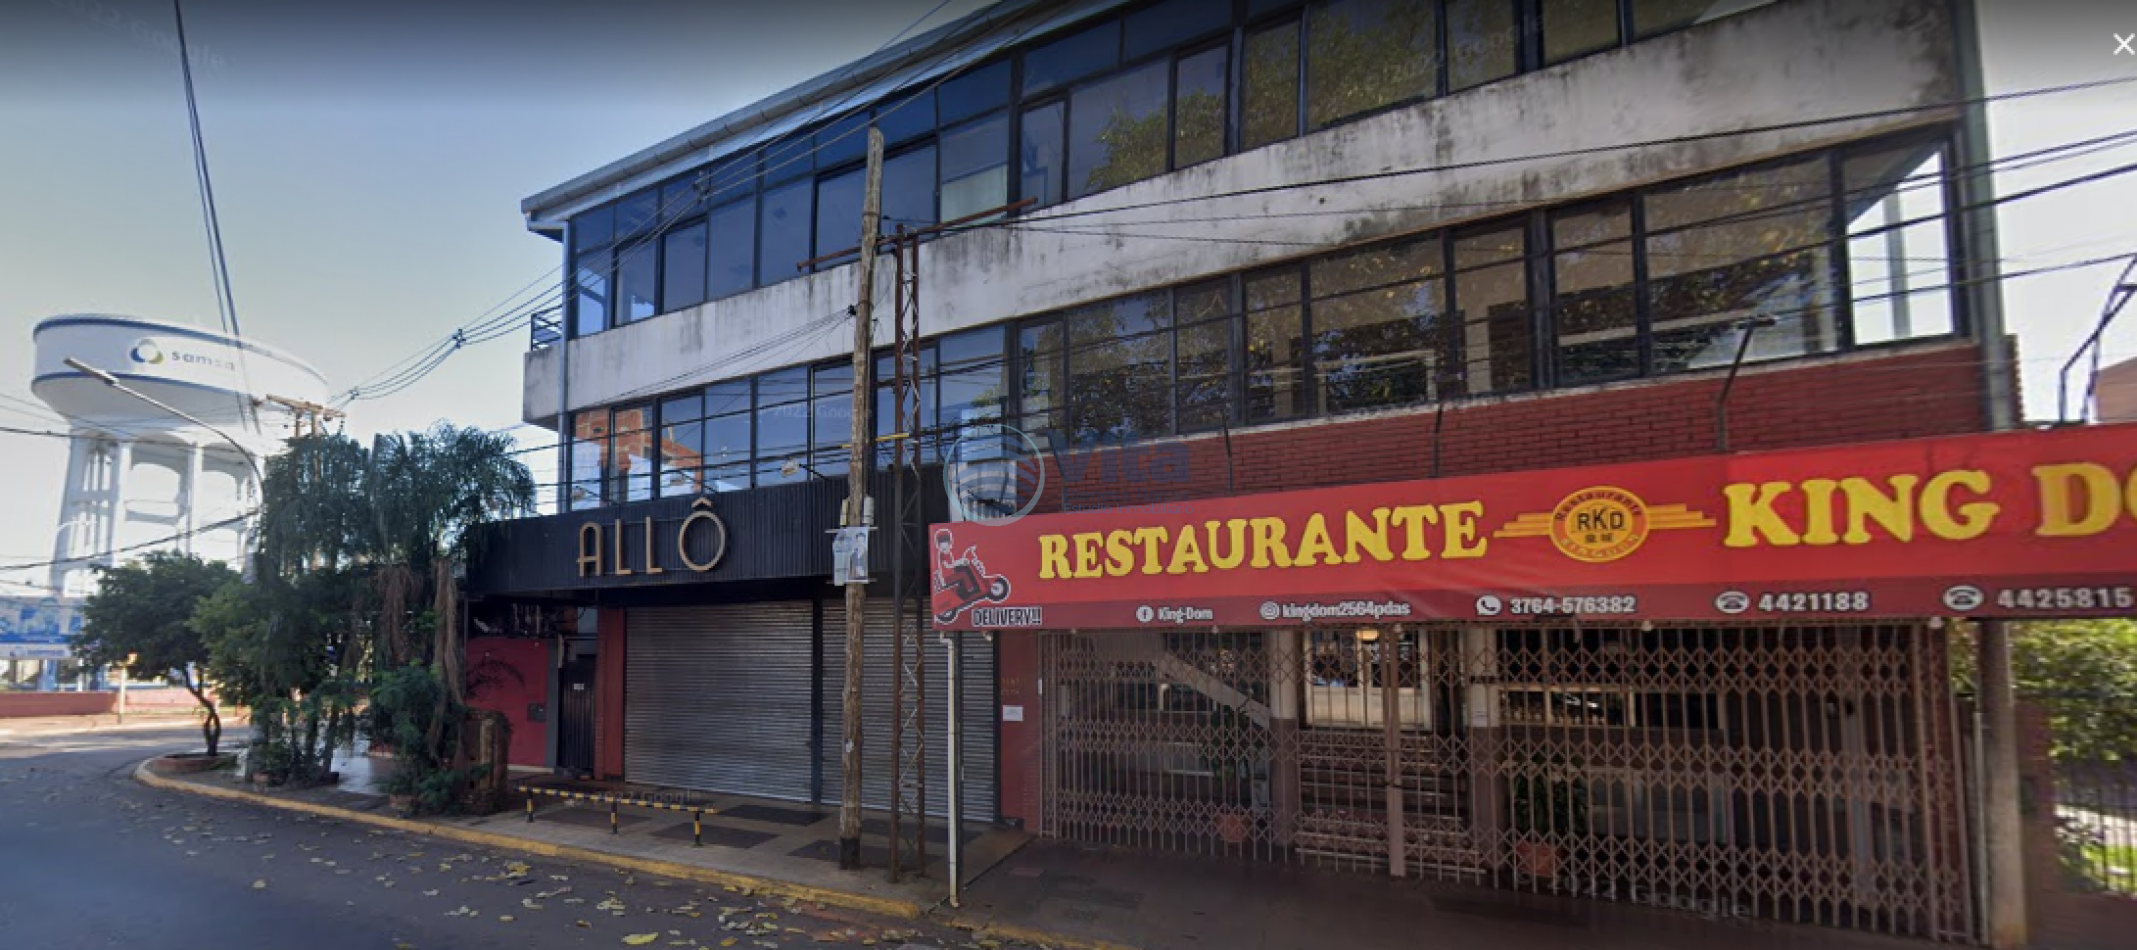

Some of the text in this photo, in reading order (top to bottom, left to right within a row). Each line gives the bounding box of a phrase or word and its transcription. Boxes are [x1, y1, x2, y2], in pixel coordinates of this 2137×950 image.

[1723, 460, 2137, 547] KING D
[1577, 506, 1624, 531] RKD
[576, 496, 726, 577] ALLÔ
[1037, 499, 1488, 579] RESTAURANTE
[1510, 596, 1637, 615] 3764-576382
[1757, 591, 1870, 612] 4421188
[972, 607, 1042, 627] DELIVERY!!
